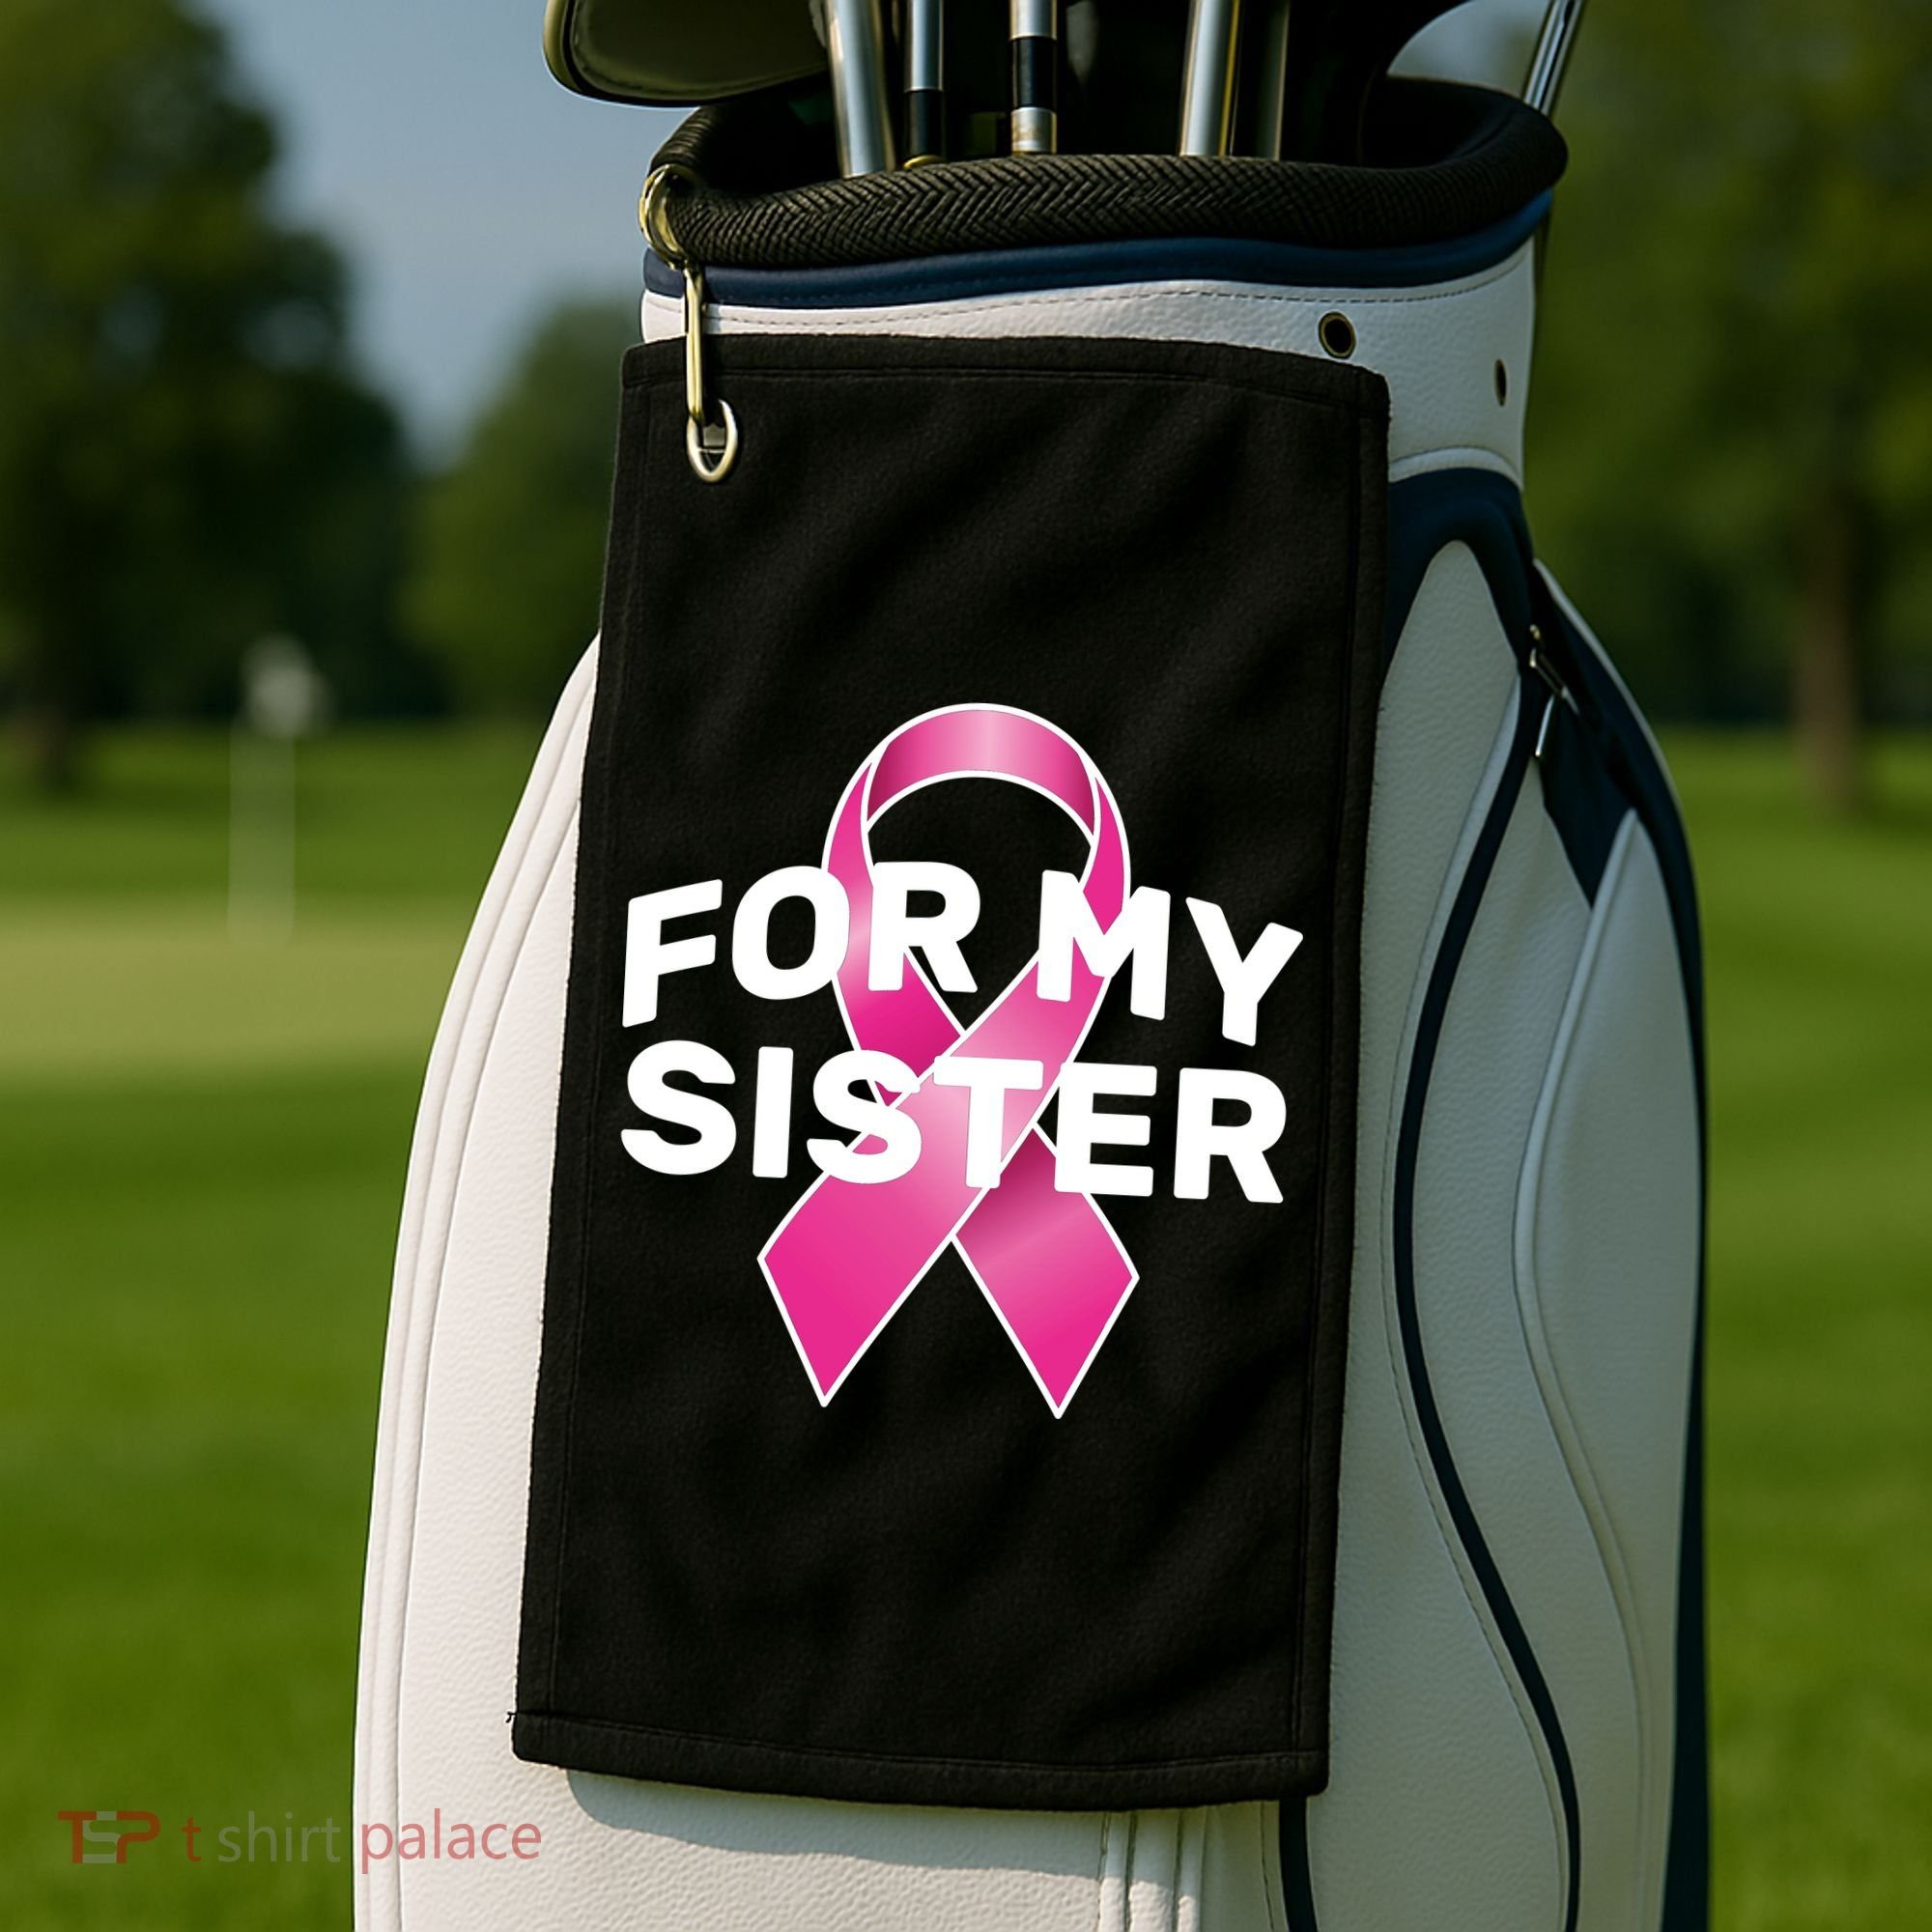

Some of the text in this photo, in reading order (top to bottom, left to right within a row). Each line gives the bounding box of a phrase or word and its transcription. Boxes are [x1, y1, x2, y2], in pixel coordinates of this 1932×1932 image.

[623, 861, 1303, 1047] FOR MY
[621, 1040, 1287, 1204] SISTER
